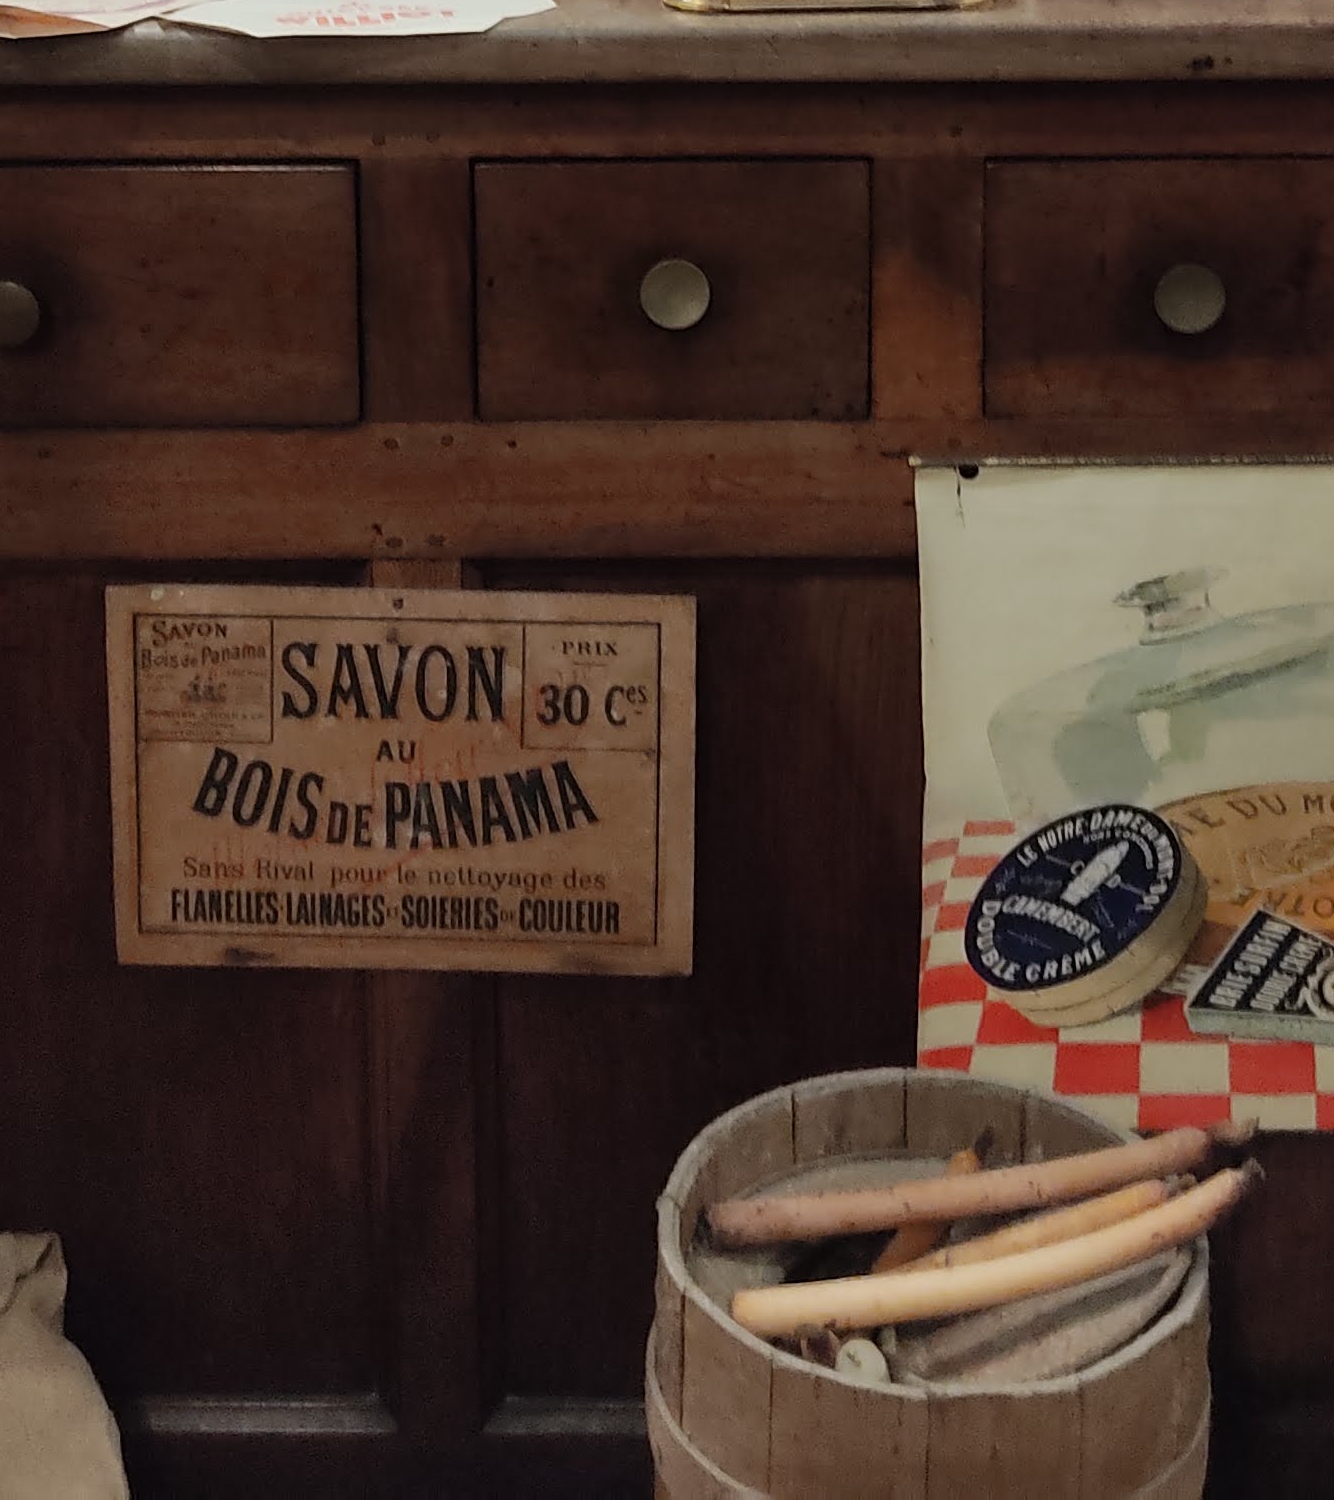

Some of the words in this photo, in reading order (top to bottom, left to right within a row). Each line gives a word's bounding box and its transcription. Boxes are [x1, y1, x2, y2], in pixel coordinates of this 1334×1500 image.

[151, 619, 228, 647] SAVON
[561, 638, 618, 658] PRIX
[200, 643, 267, 667] Panama
[280, 641, 508, 723] SAVON
[538, 682, 591, 728] 30
[375, 739, 418, 765] AU
[192, 745, 324, 843] BOIS
[326, 798, 373, 849] DE
[384, 759, 600, 852] PANAMA
[183, 856, 245, 881] Sans
[330, 863, 391, 891] pour
[397, 861, 419, 887] le
[427, 863, 555, 897] nettoyage
[562, 866, 608, 891] des
[170, 888, 280, 925] FLANELLES
[285, 891, 386, 928] LAINAGES
[400, 894, 499, 931] SOIERIES
[518, 898, 621, 936] COULEUR
